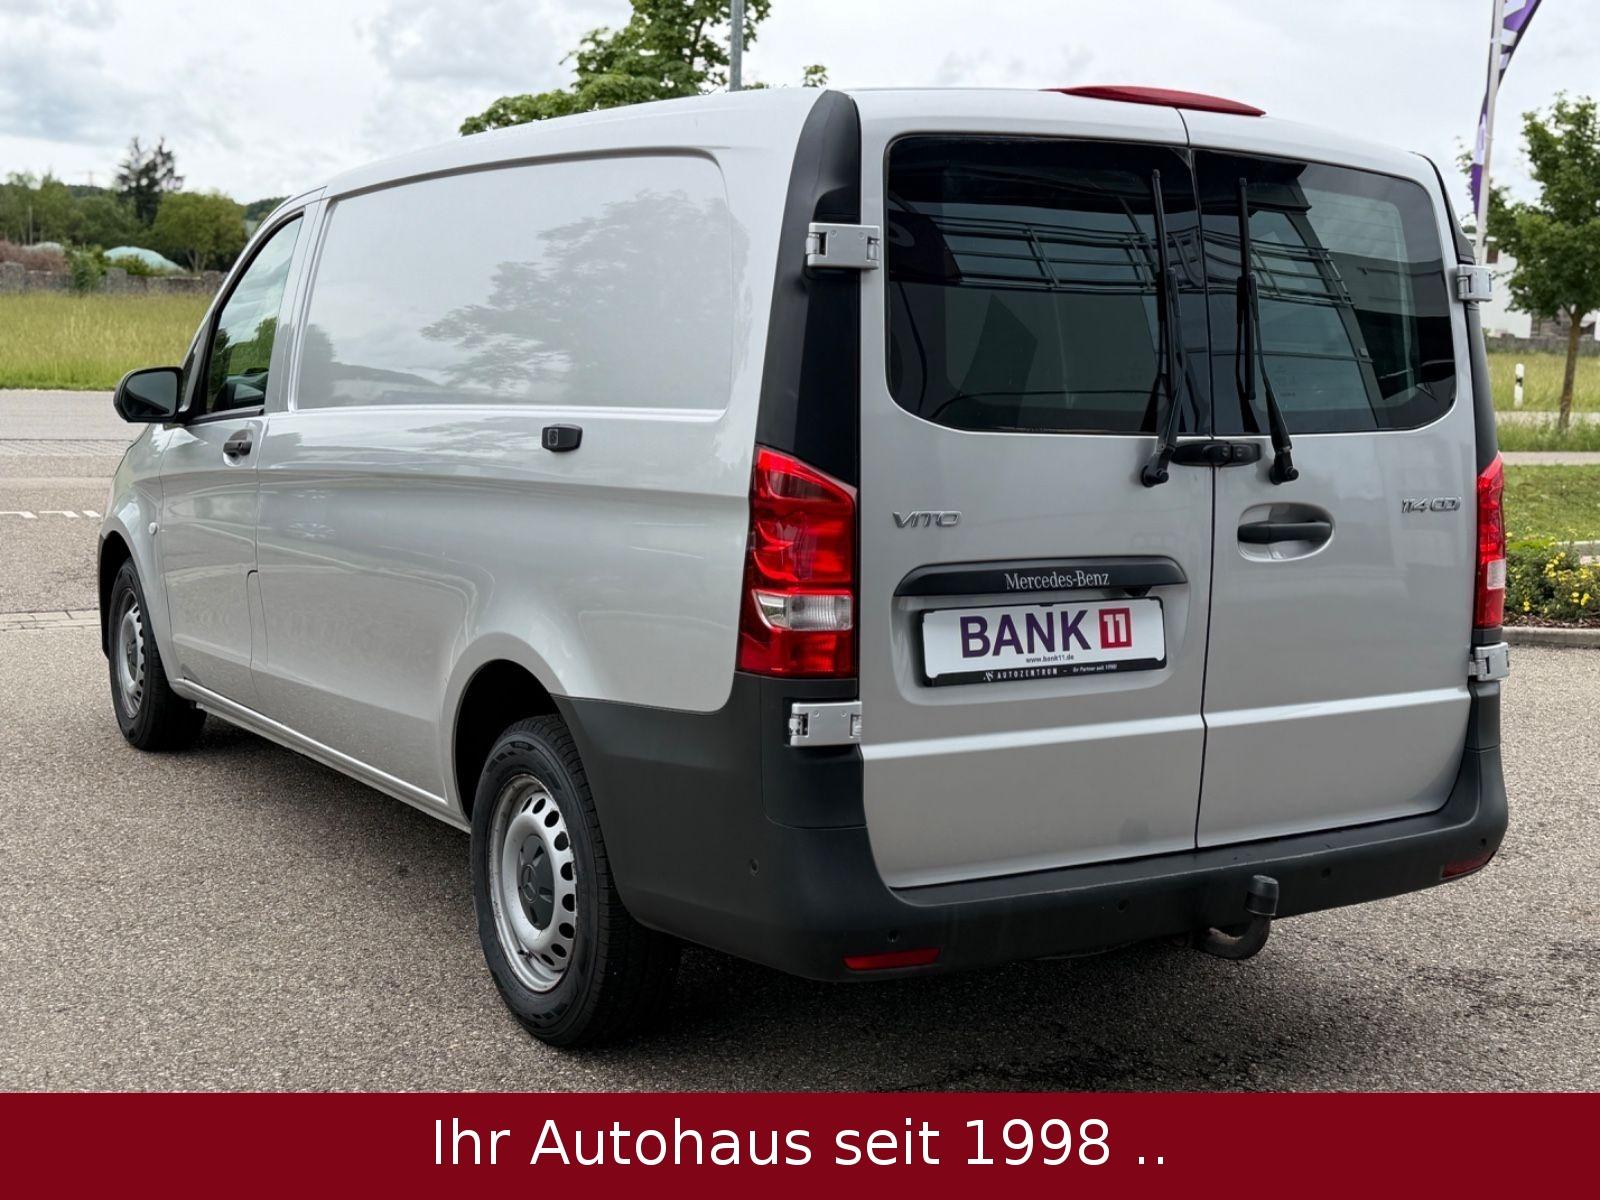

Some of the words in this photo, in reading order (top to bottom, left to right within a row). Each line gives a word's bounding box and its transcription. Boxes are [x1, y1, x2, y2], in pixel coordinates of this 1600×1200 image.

[892, 510, 962, 528] VITO
[1004, 570, 1110, 590] Mercedes-Benz
[960, 609, 1092, 659] BANK
[1102, 611, 1129, 645] 11
[1025, 653, 1075, 664] www.bank11.de
[997, 667, 1058, 679] AUTOZENTRUM
